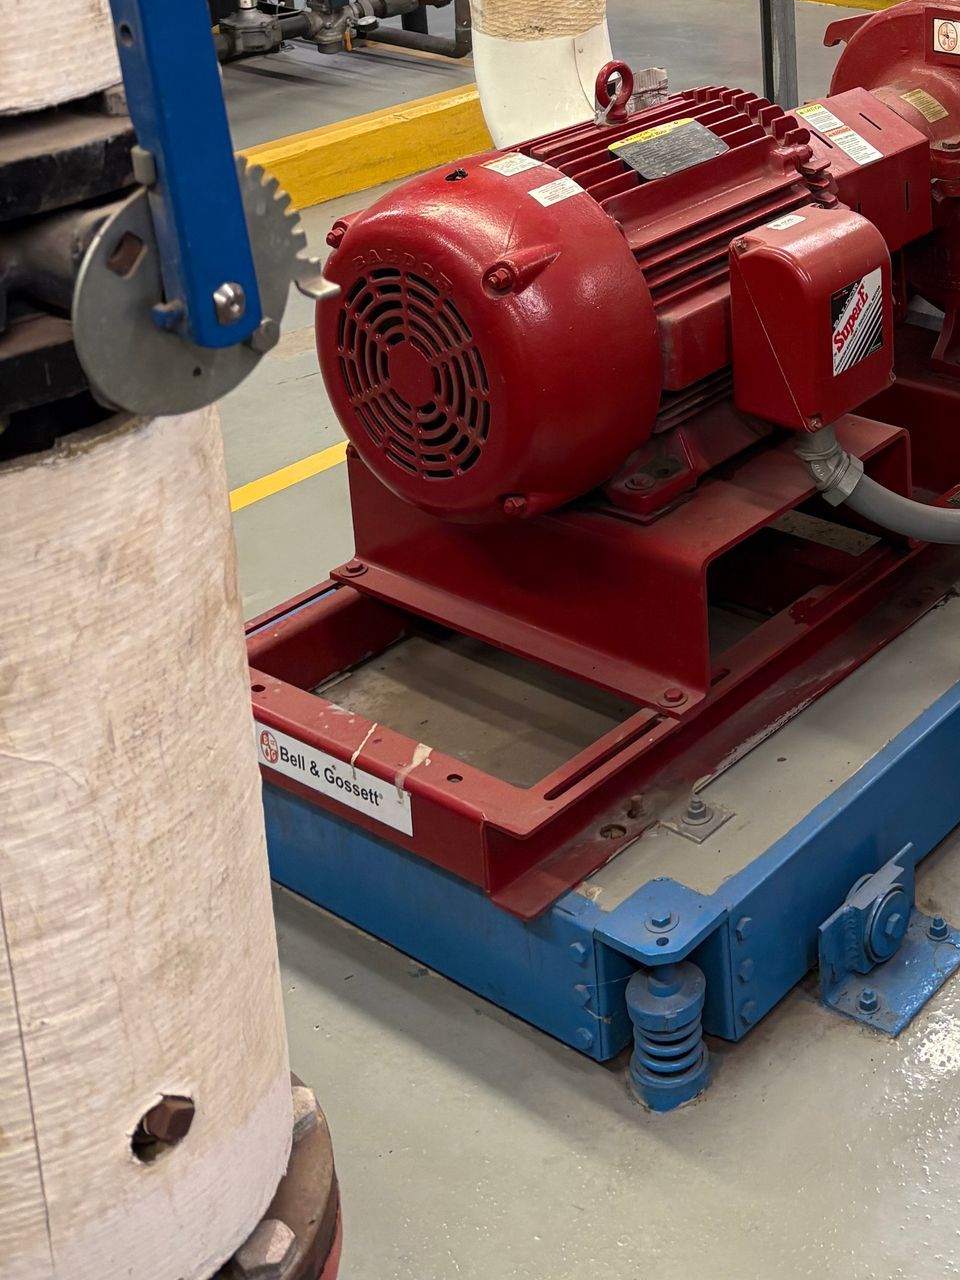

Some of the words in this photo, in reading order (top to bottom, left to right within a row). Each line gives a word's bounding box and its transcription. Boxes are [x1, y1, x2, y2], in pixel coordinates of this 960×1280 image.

[833, 282, 859, 329] BALDOR
[280, 745, 305, 770] Bell
[310, 760, 320, 778] &
